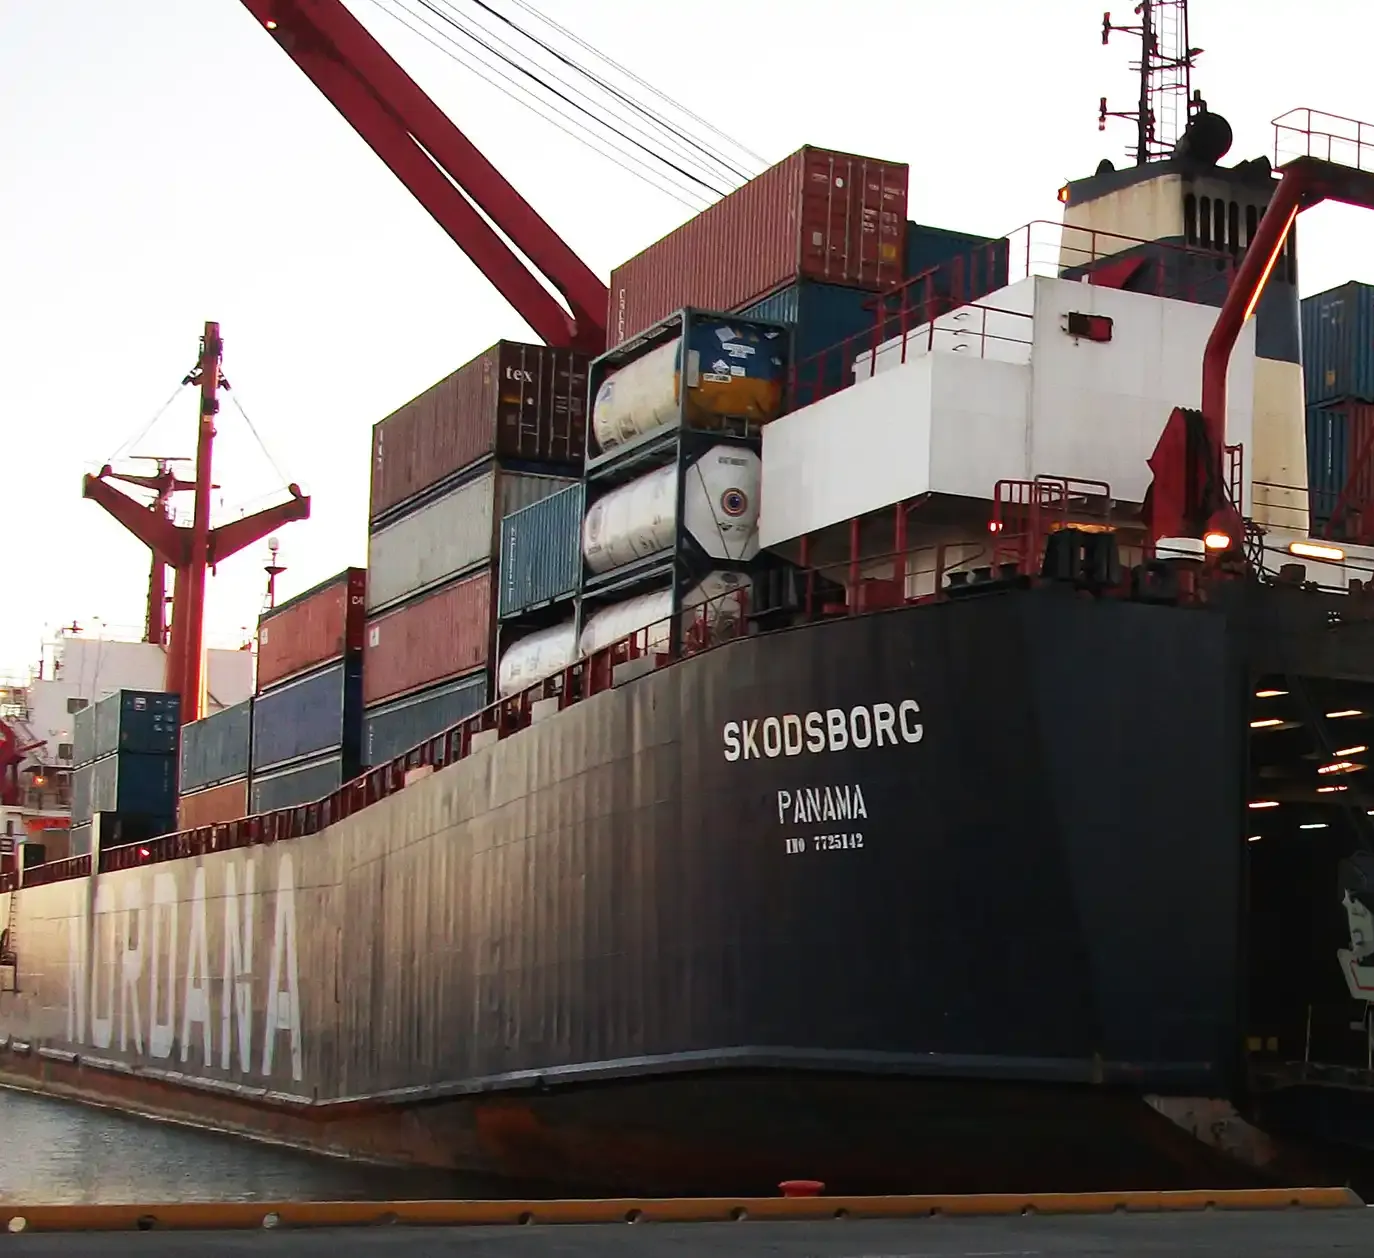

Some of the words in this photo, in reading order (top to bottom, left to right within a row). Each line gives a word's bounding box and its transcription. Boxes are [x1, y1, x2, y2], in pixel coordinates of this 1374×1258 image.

[505, 365, 533, 383] tex
[723, 699, 924, 762] SKODSBORG
[777, 784, 868, 824] PANAMA
[813, 832, 864, 851] 7725142
